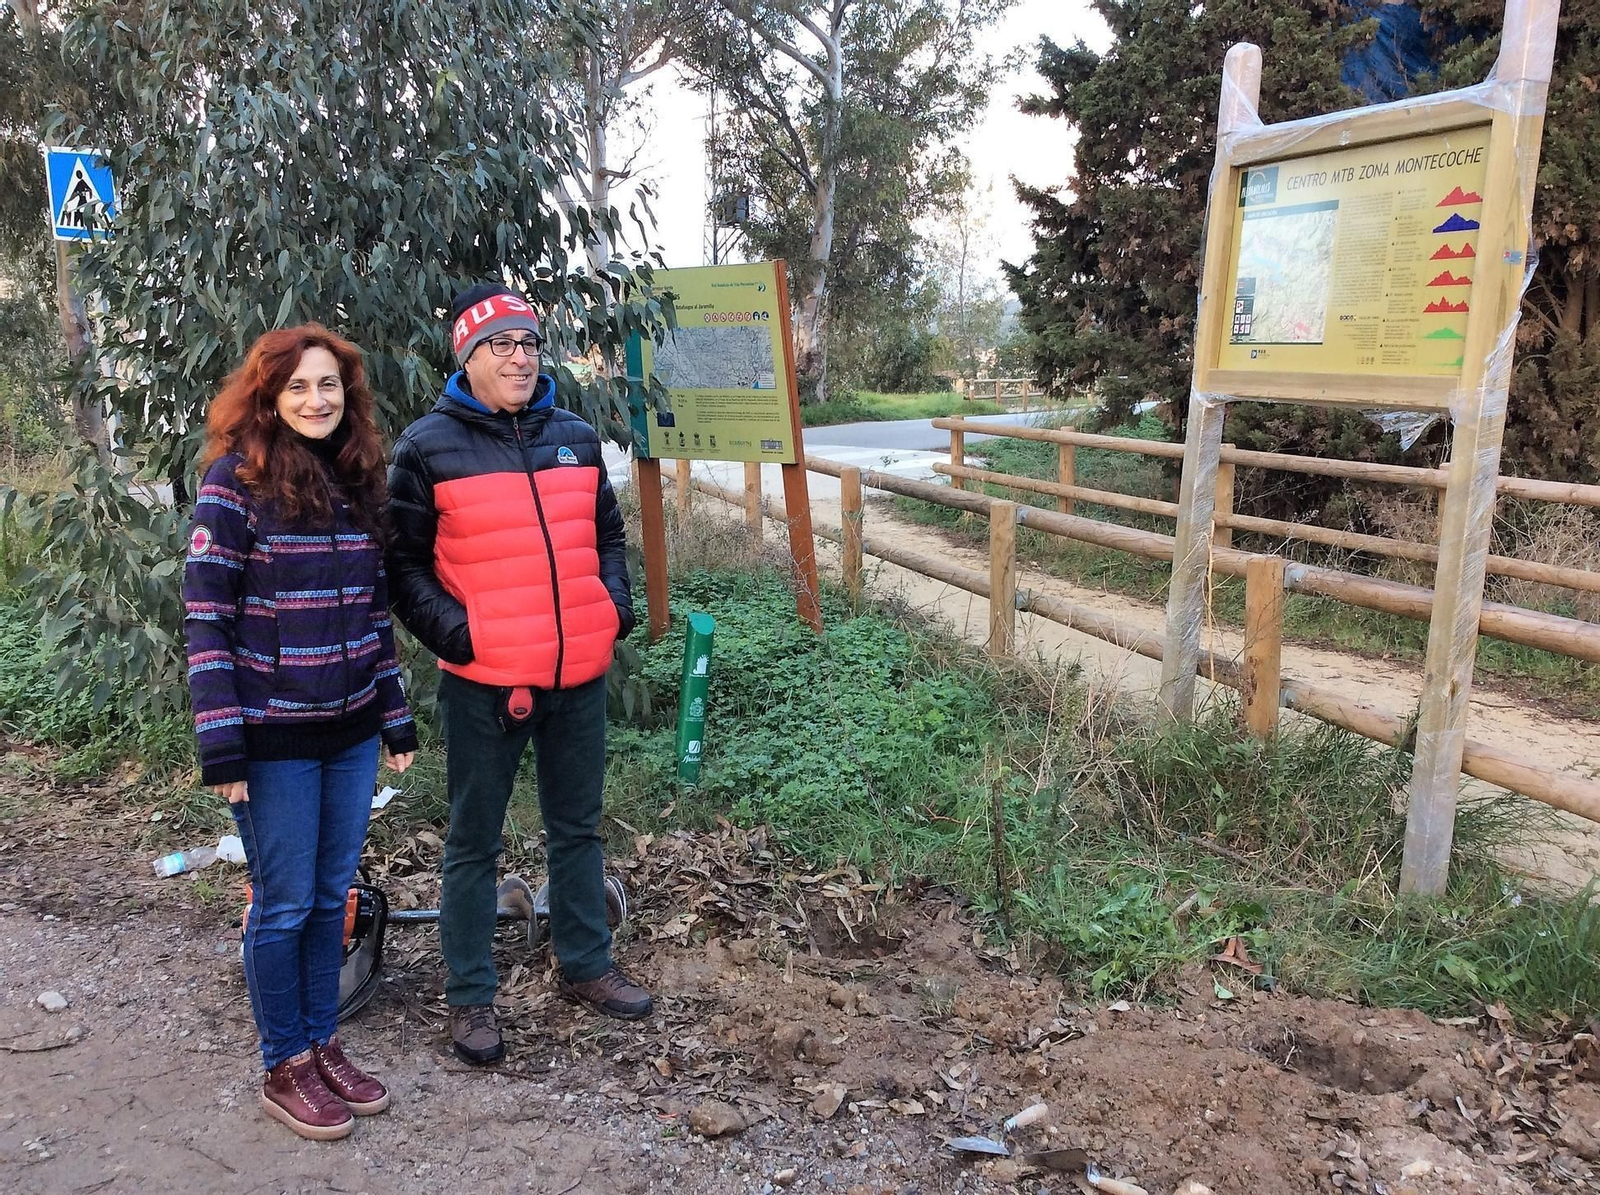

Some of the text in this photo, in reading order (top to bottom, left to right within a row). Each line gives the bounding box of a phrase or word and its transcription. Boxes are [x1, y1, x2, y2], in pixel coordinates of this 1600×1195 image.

[1286, 146, 1484, 191] CENTRO MTB ZONA MONTECOCHE
[454, 296, 537, 346] RUS
